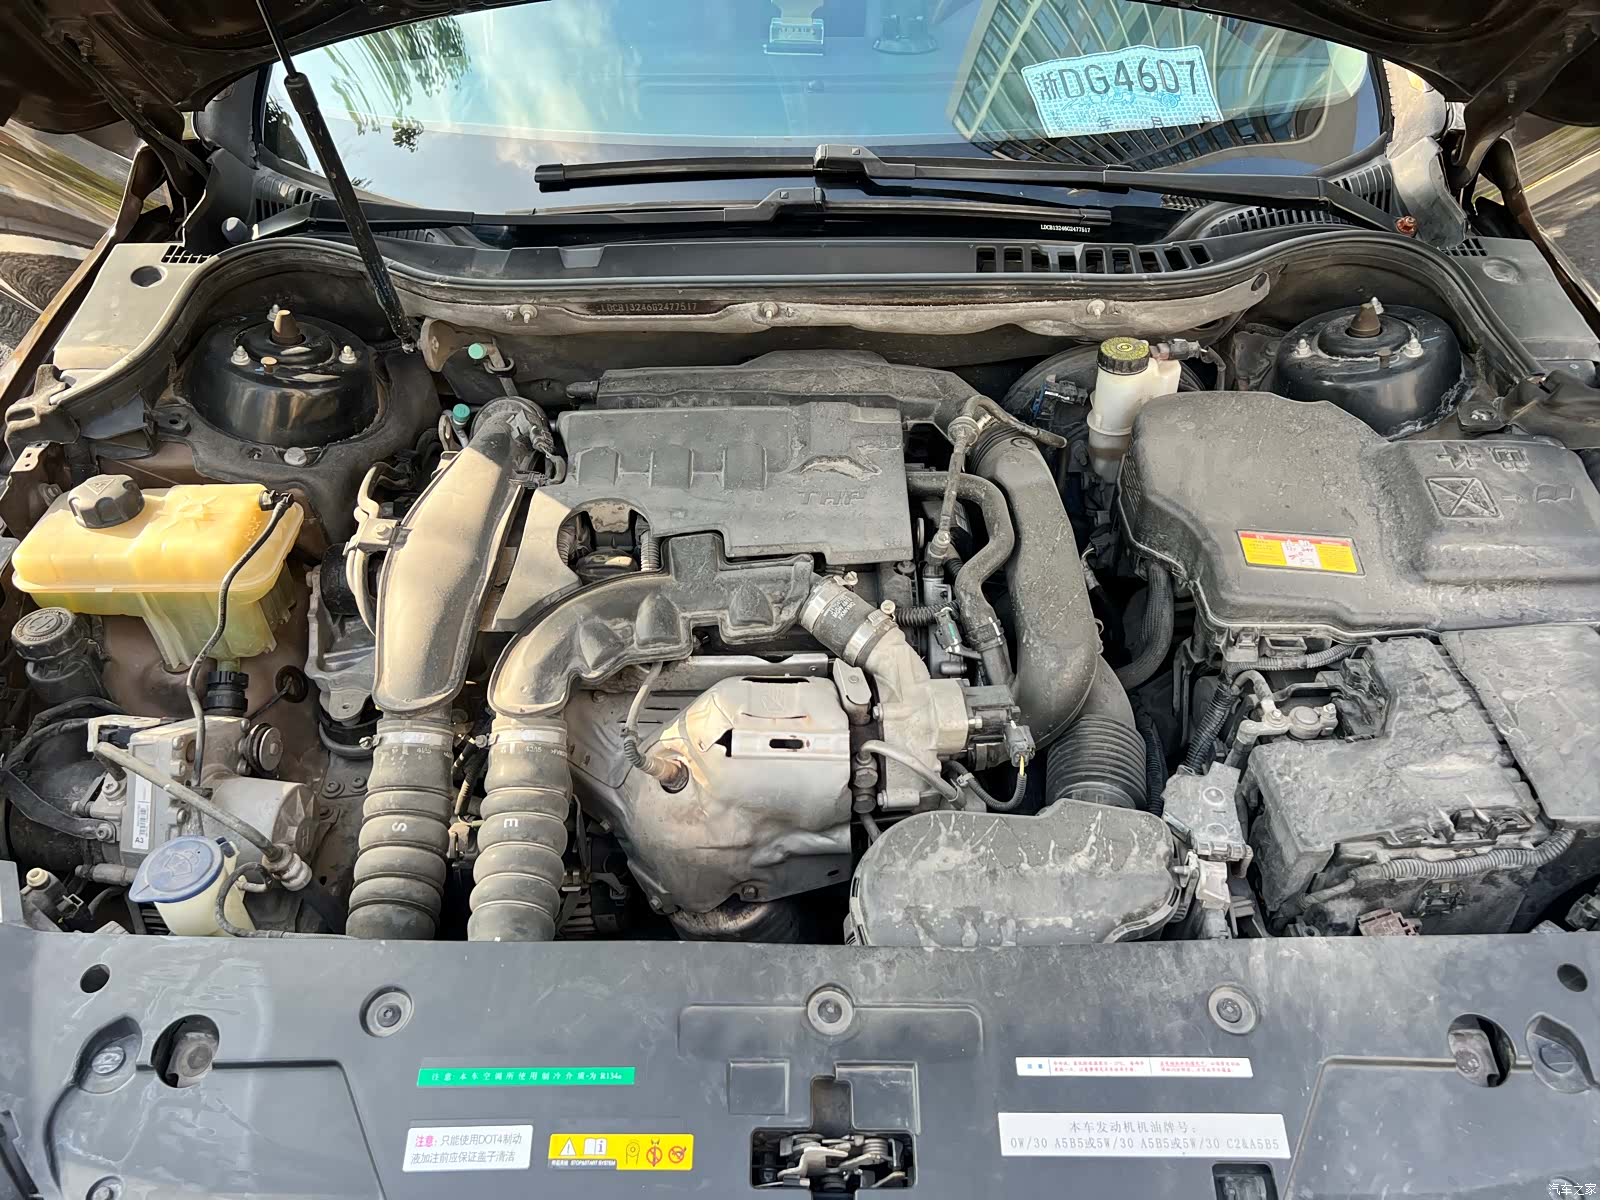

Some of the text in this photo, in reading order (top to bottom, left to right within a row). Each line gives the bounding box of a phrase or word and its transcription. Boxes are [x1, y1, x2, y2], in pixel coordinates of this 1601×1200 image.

[1034, 57, 1196, 101] 浙DG4607
[798, 491, 864, 506] THP
[1010, 1137, 1048, 1150] 0W/30
[1226, 1137, 1280, 1151] C2&A5B5
